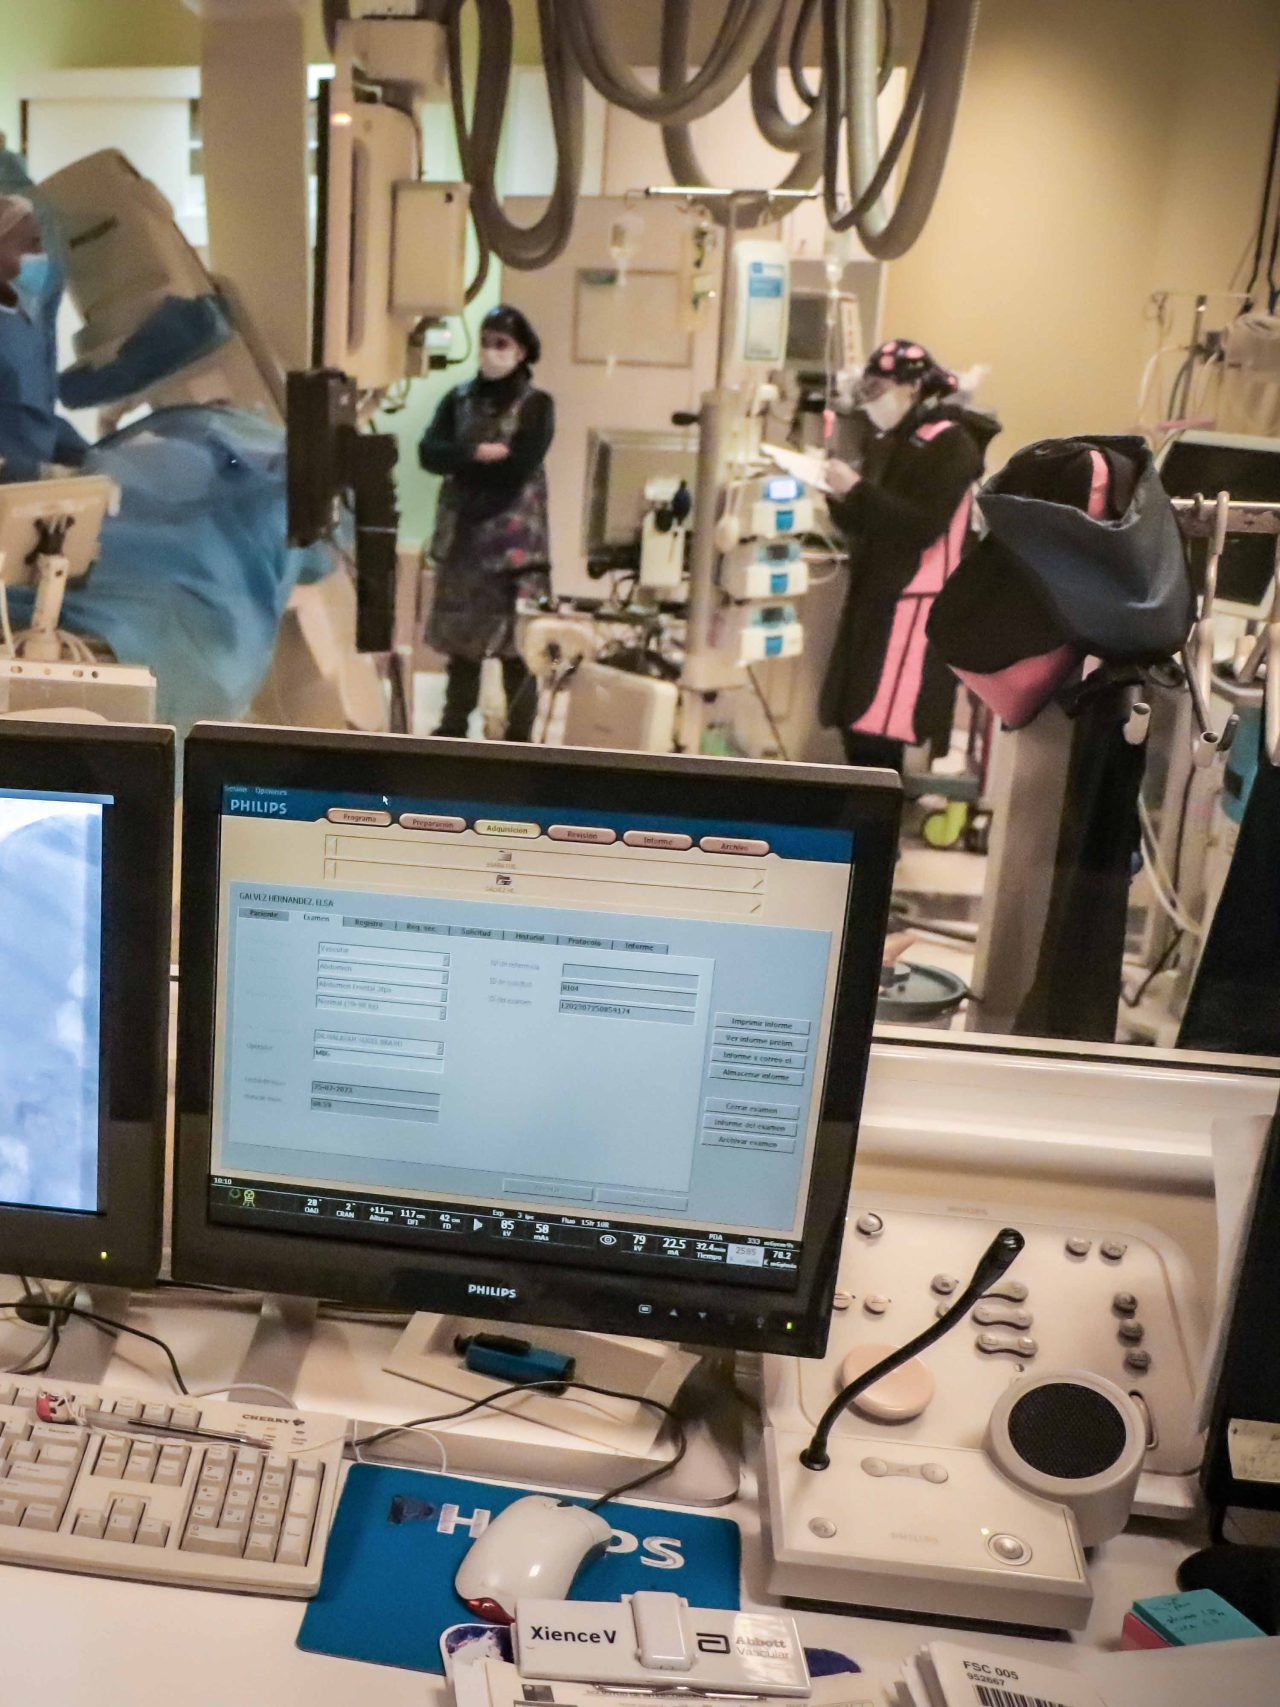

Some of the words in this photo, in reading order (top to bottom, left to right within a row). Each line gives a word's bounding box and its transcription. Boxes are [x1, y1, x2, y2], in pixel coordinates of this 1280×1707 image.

[230, 799, 288, 815] PHILIPS
[343, 813, 377, 823] Programa
[303, 914, 330, 922] Examen
[214, 1177, 232, 1185] 10:10
[439, 1214, 451, 1222] 42
[492, 1209, 505, 1218] Exp
[500, 1220, 515, 1230] 85
[535, 1223, 550, 1234] 58
[533, 1234, 550, 1242] mAs
[632, 1234, 647, 1245] 79
[662, 1237, 687, 1249] 22.5
[696, 1251, 723, 1261] Tiempo
[468, 1284, 517, 1299] PHILIPS
[242, 1414, 290, 1424] CHERRY
[530, 1625, 601, 1643] Xience
[603, 1629, 617, 1644] V
[735, 1636, 787, 1648] Abbott
[736, 1647, 790, 1659] Vascular
[963, 1660, 992, 1674] FSC
[995, 1667, 1019, 1680] 005
